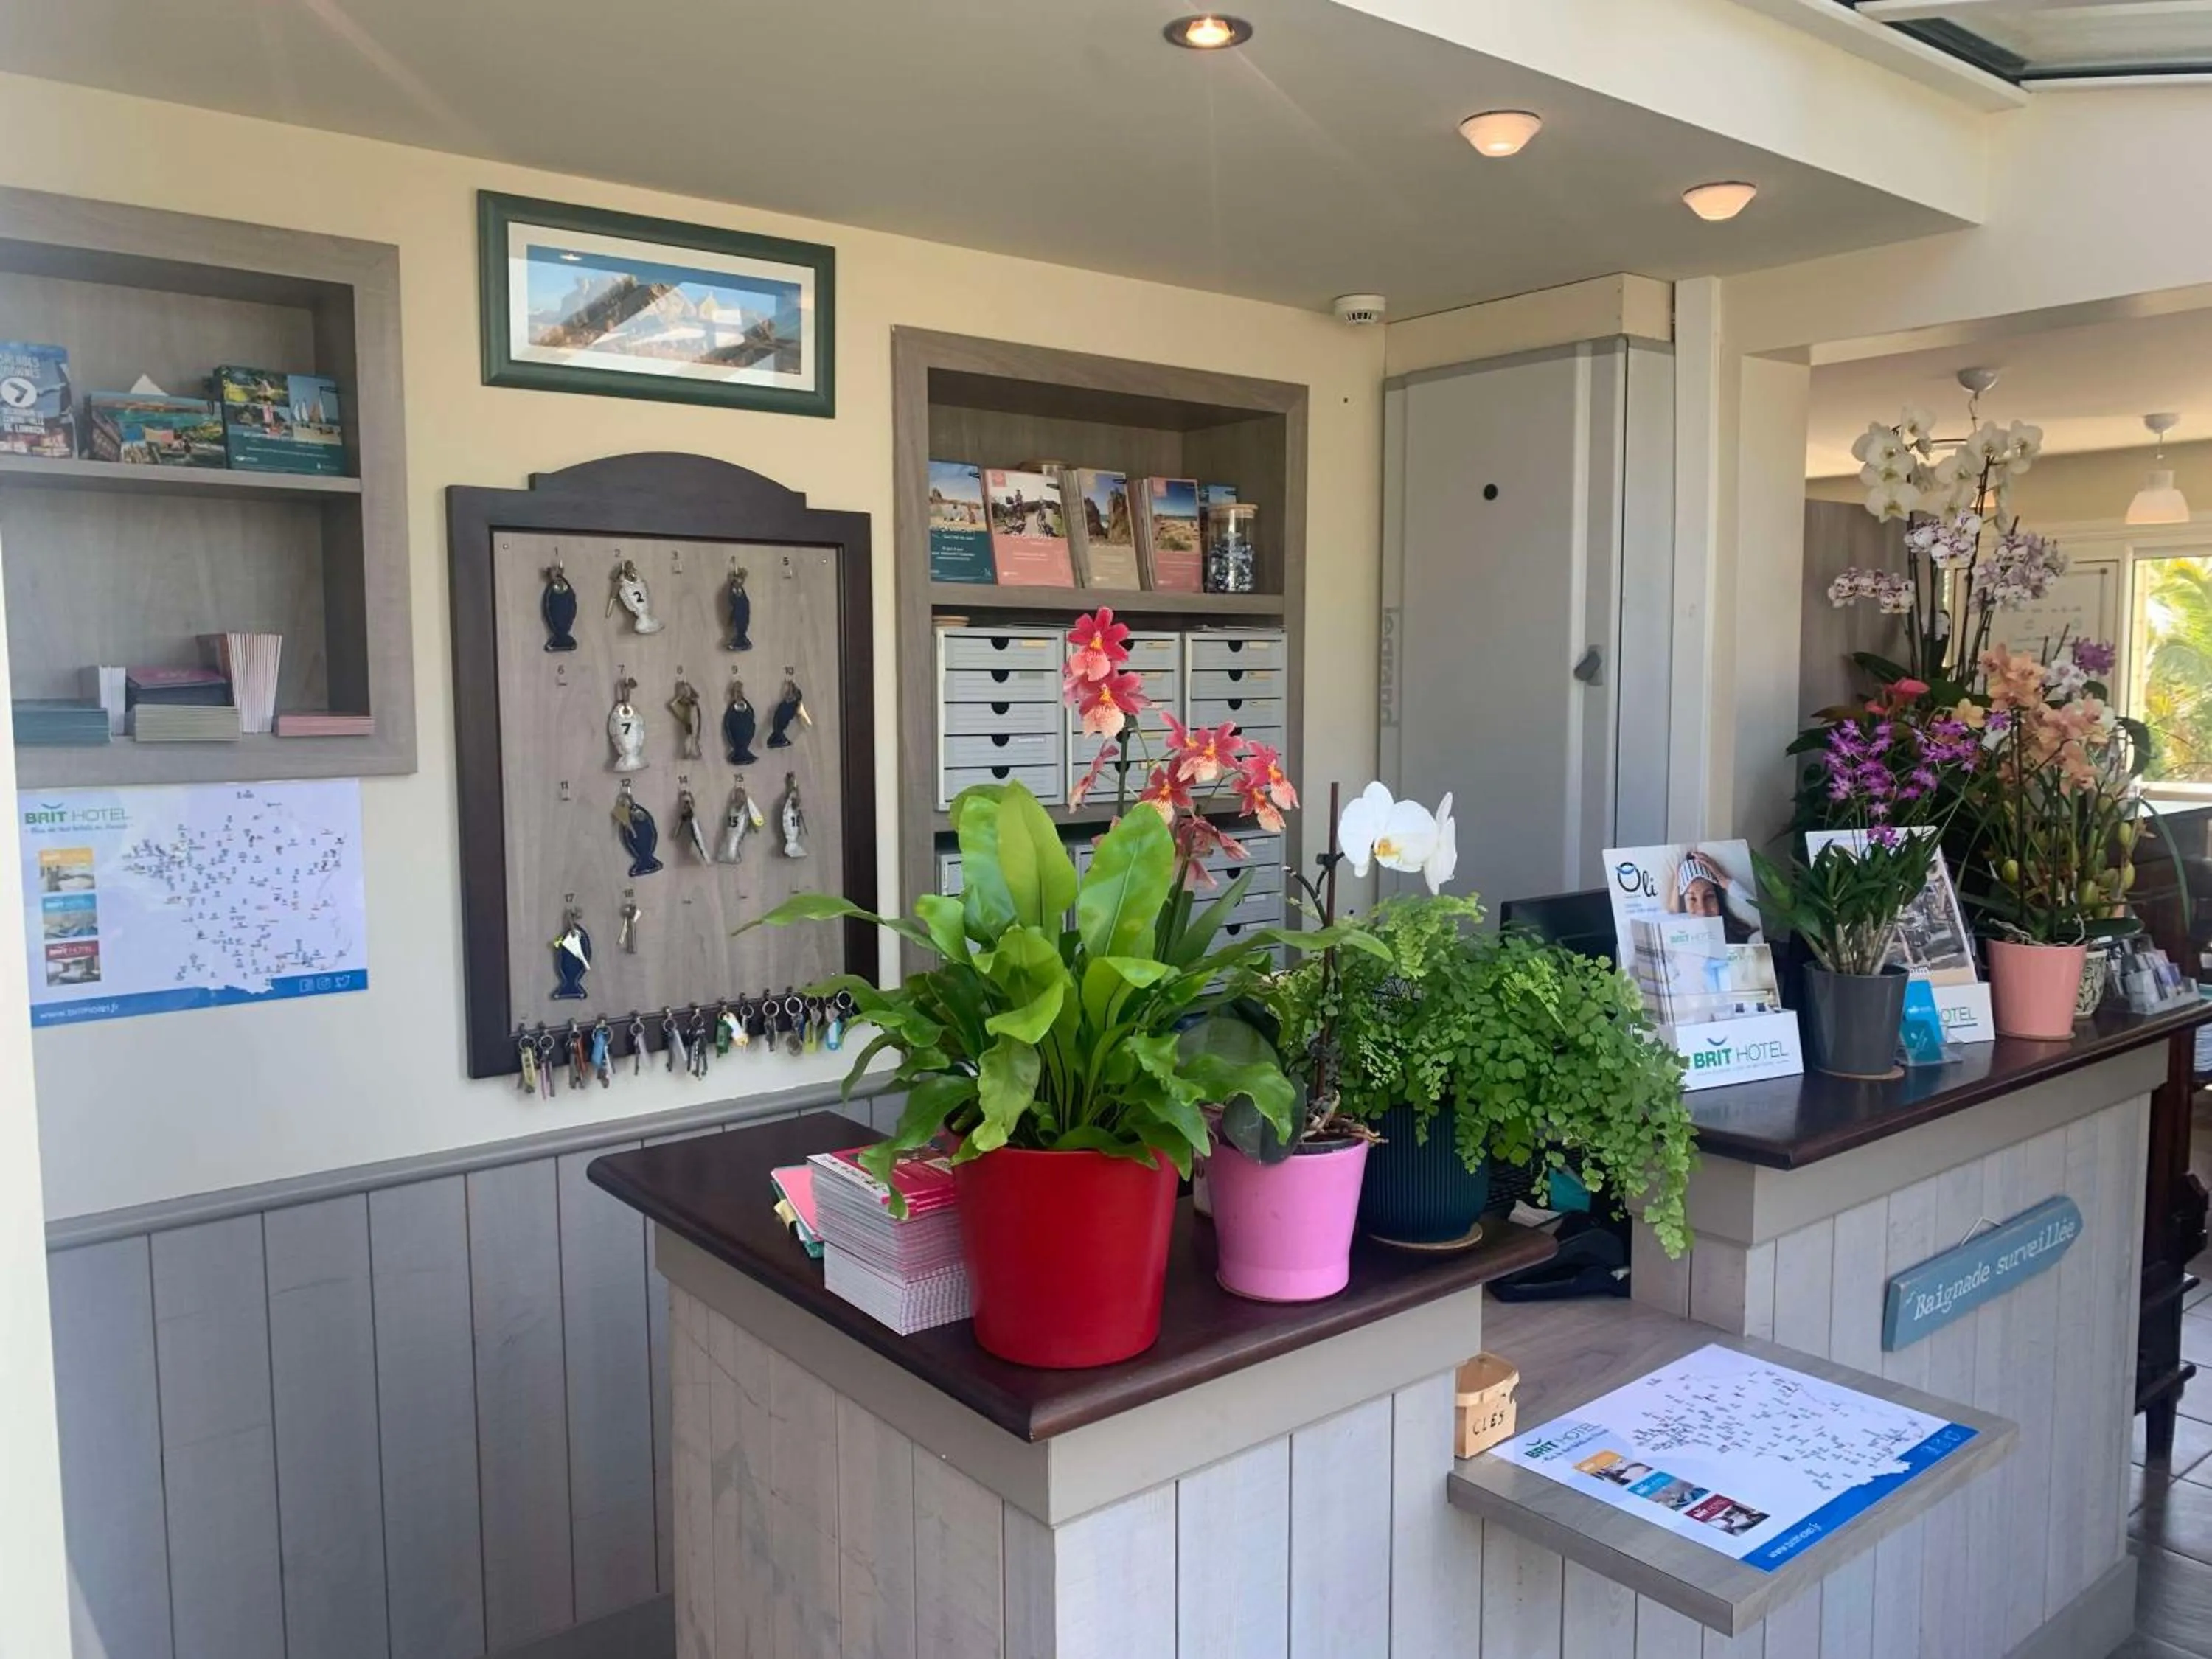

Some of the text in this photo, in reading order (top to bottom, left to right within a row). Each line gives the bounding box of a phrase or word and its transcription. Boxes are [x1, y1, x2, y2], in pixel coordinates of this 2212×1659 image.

[614, 549, 621, 557] 2
[672, 550, 678, 560] 3
[782, 557, 790, 566] 5
[633, 591, 645, 603] 2
[617, 665, 625, 675] 7
[731, 665, 738, 675] 9
[785, 666, 795, 675] 10
[621, 722, 632, 734] 7
[560, 780, 568, 790] 11
[621, 779, 632, 787] 12
[24, 807, 133, 824] BRIT HOTEL
[1615, 861, 1658, 897] Oli
[564, 892, 575, 902] 17
[1938, 1006, 1978, 1023] OTEL
[1693, 1047, 1733, 1069] BRIT
[1736, 1040, 1790, 1062] HOTEL
[1913, 1262, 1990, 1321] Baignade
[1523, 1440, 1559, 1459] BRIT
[1554, 1422, 1603, 1444] HOTEL
